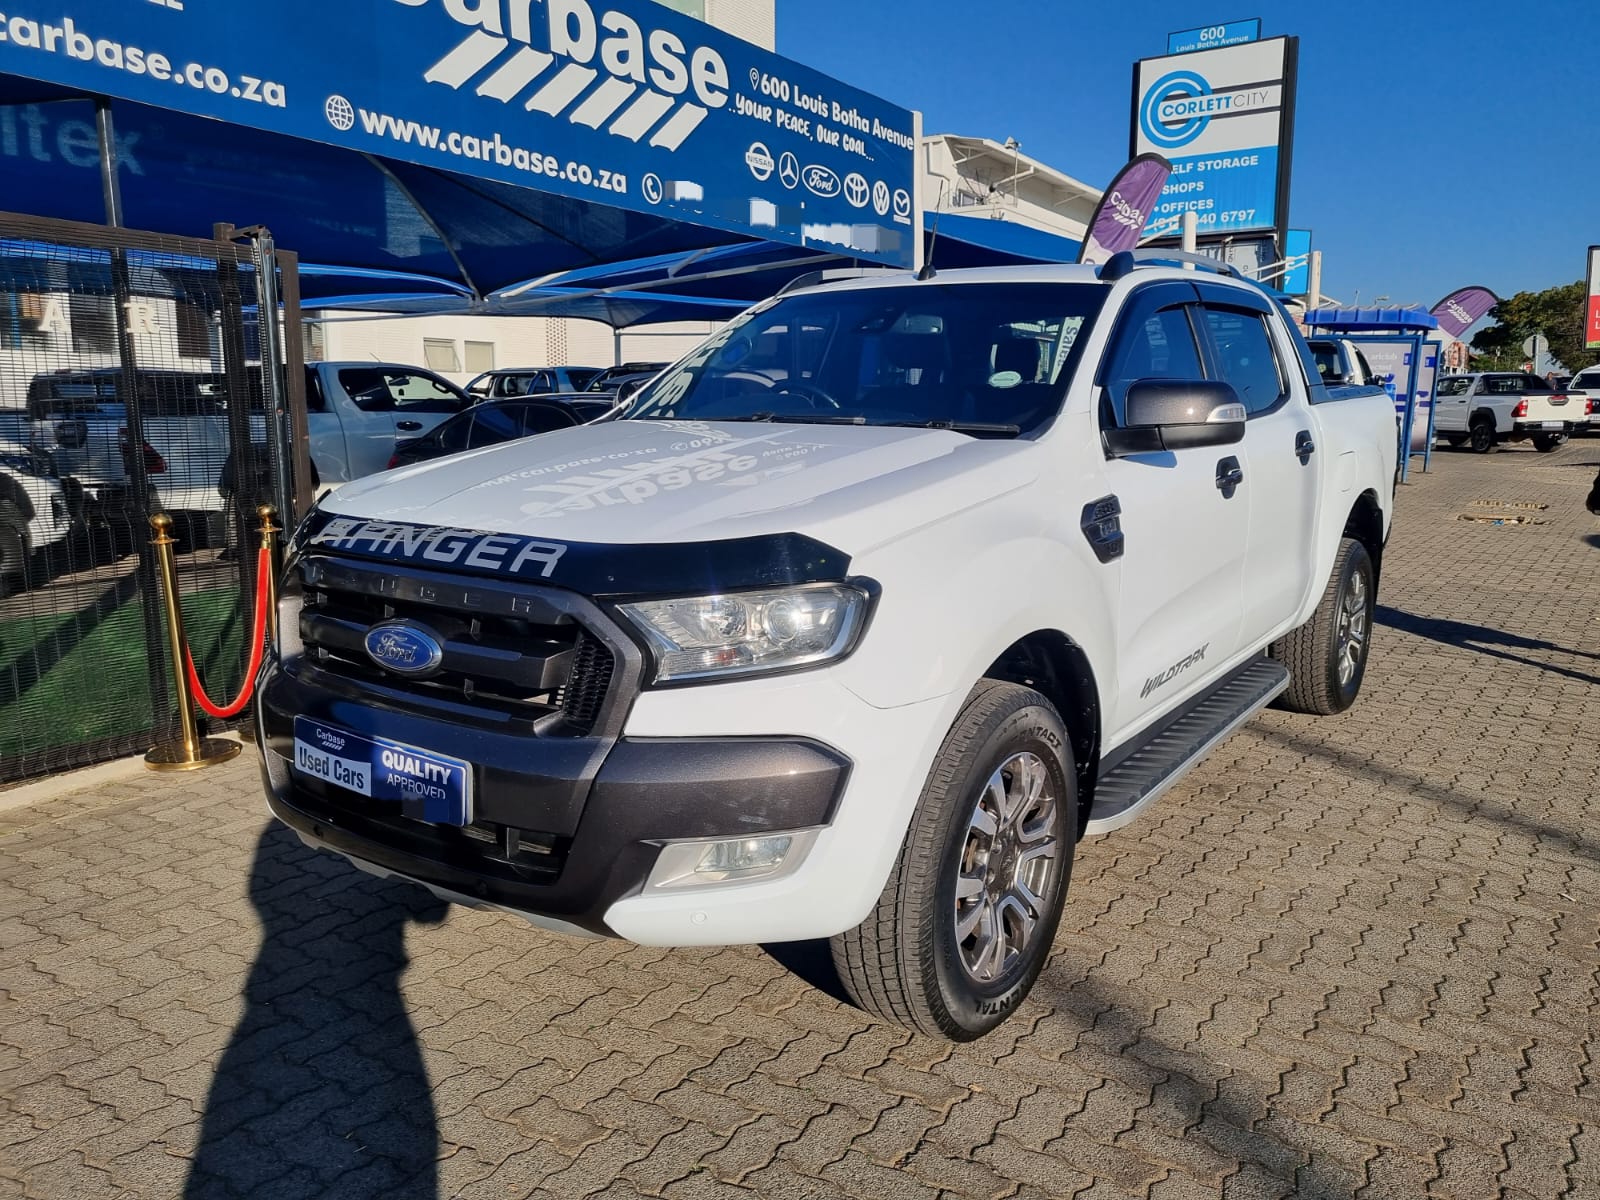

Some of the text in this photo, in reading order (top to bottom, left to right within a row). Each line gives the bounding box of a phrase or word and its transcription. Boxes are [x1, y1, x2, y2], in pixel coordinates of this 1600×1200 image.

[1175, 35, 1249, 52] Louis Botha Avenue
[1200, 26, 1225, 41] 600
[760, 73, 914, 150] 600 Louis Botha Avenue
[776, 109, 813, 141] PEACE,
[816, 124, 839, 147] OUR
[358, 108, 627, 193] www.carbase.co.za
[747, 154, 773, 169] NISSAN
[1171, 155, 1259, 175] ELF STORAGE
[808, 168, 834, 192] Ford
[1162, 181, 1204, 195] SHOPS
[1161, 198, 1214, 213] OFFICES
[1220, 209, 1256, 223] 6797
[310, 517, 568, 577] RANGER
[376, 632, 418, 663] Ford
[1139, 642, 1210, 699] WILDTRAK
[316, 728, 345, 746] Carbase
[299, 746, 364, 789] Used Cars
[381, 750, 452, 785] QUALITY
[386, 773, 447, 800] APPROVED
